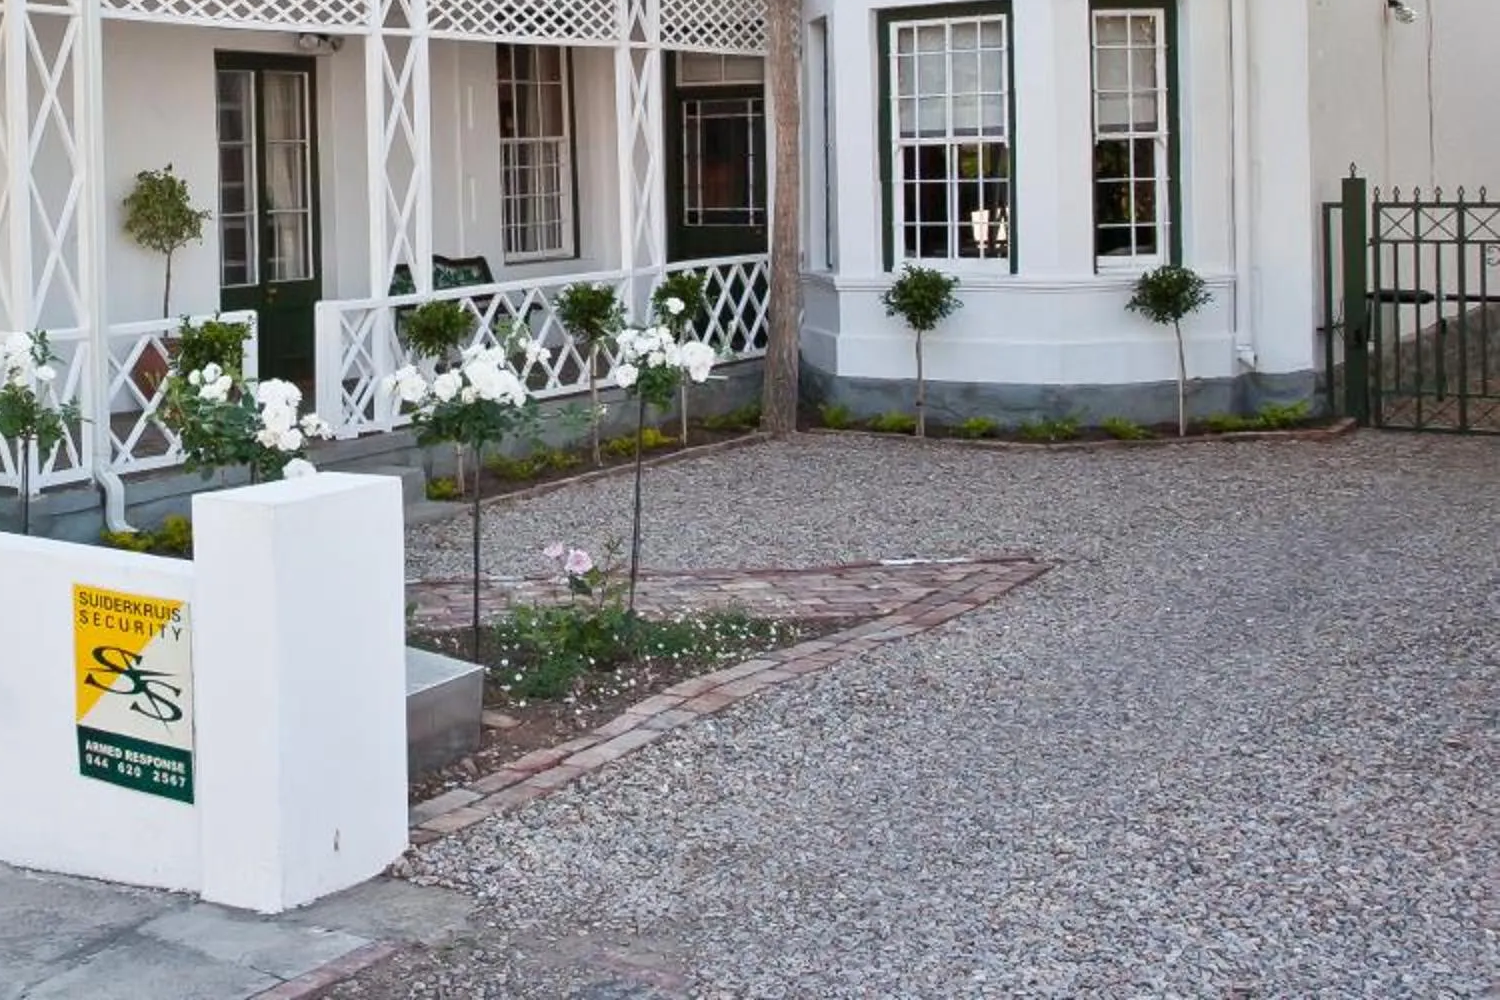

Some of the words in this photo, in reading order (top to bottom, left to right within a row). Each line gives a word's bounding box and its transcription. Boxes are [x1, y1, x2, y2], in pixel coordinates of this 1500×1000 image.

[79, 591, 182, 623] SUIDERKRUIS
[79, 609, 182, 642] SECURITY
[85, 740, 122, 759] ARMED
[124, 750, 185, 774] RESPONSE
